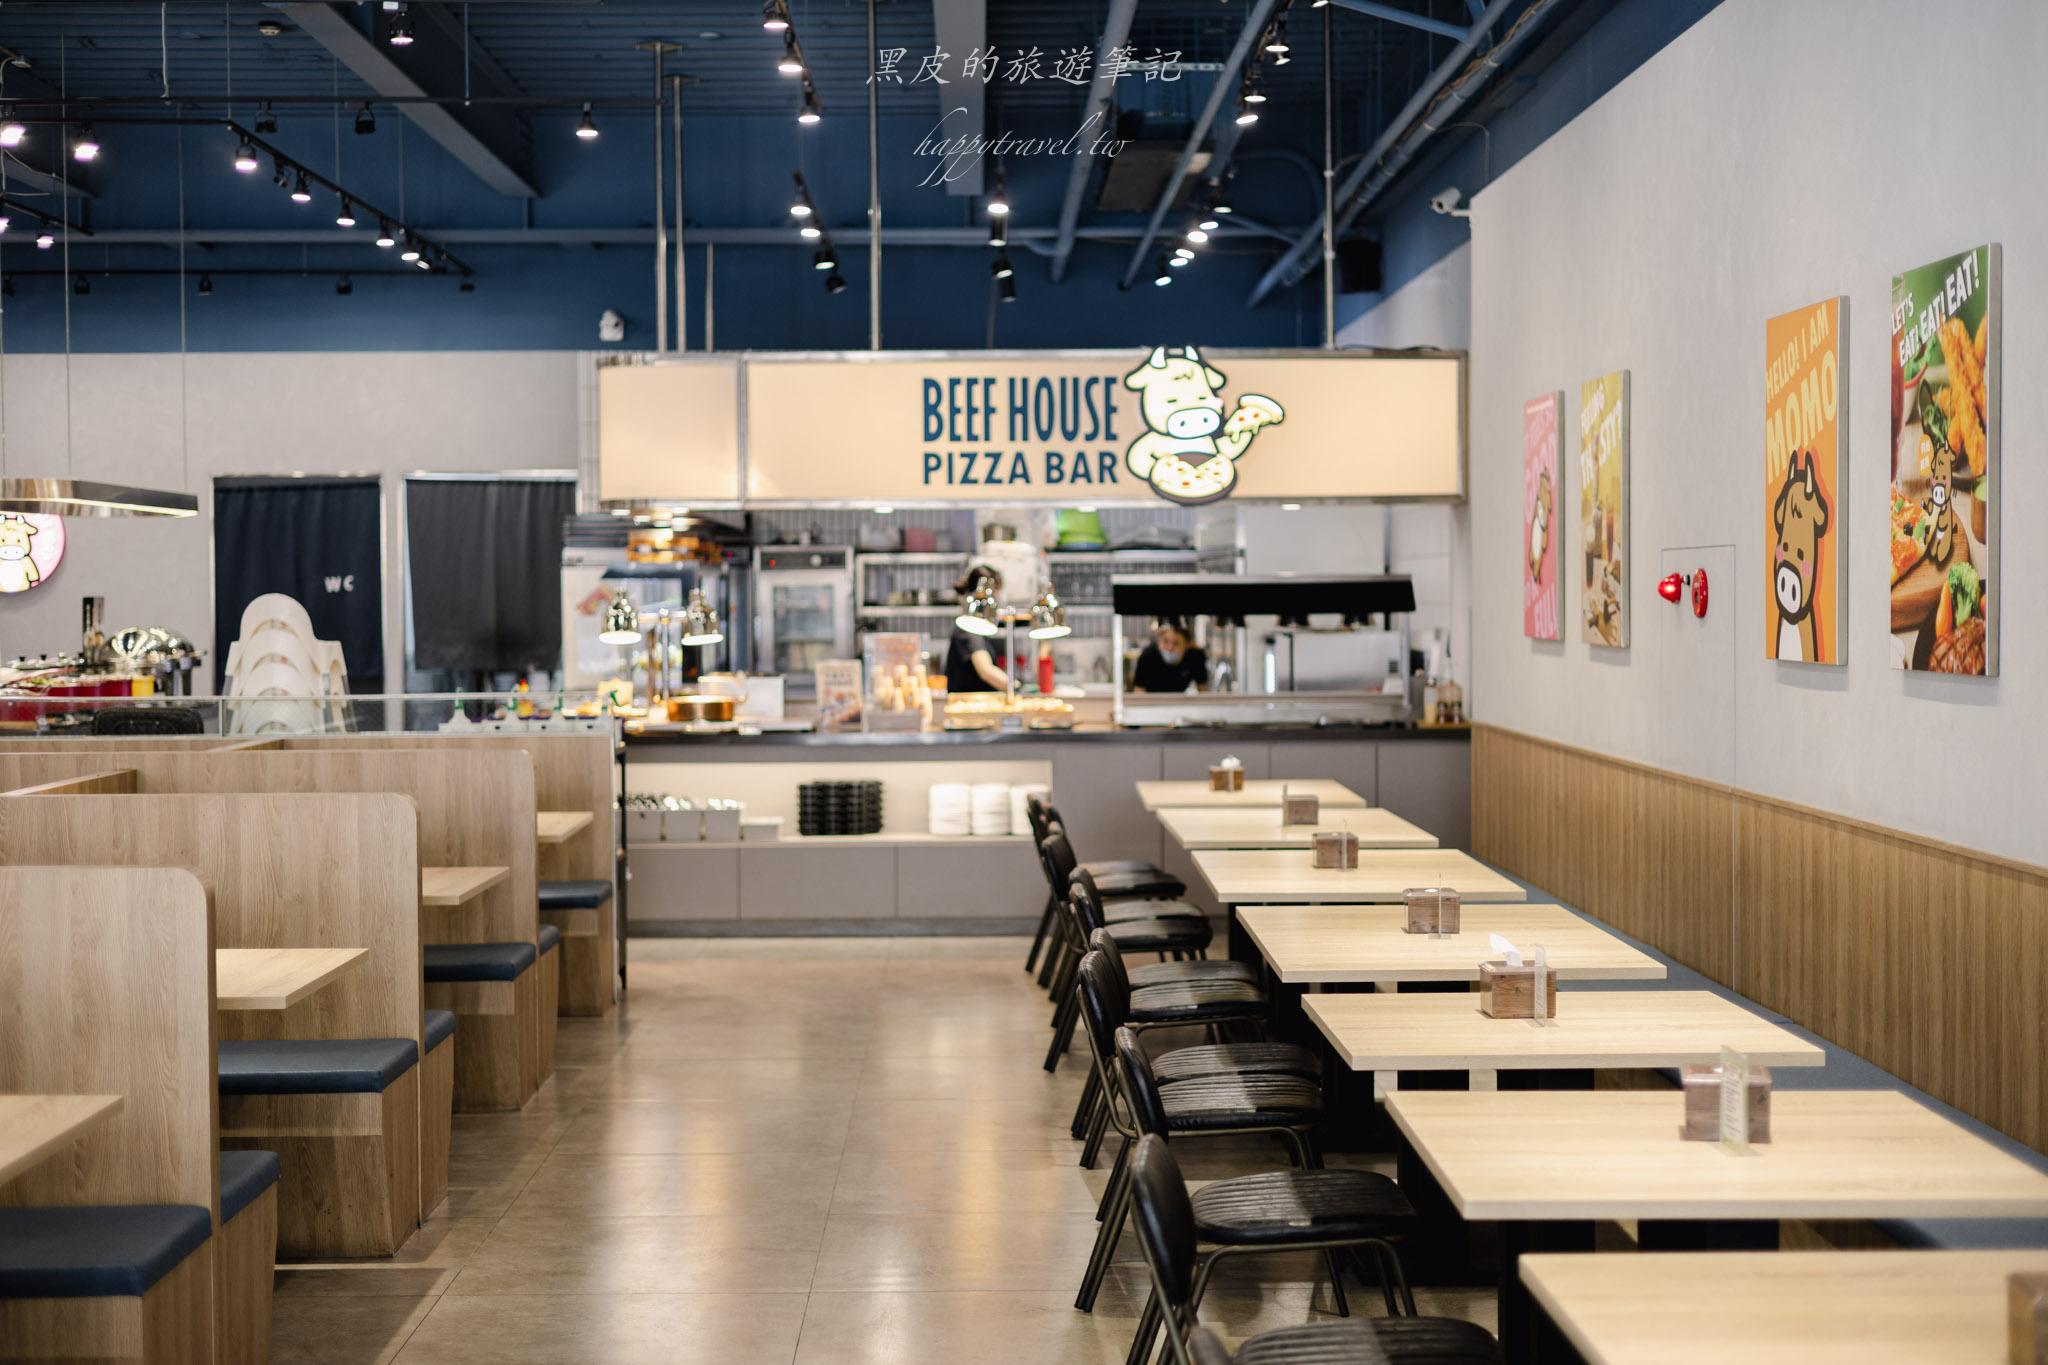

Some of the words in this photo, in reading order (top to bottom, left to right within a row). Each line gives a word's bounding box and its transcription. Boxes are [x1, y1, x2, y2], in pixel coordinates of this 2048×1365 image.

[1892, 292, 1914, 336] LET'S
[1900, 329, 1921, 368] EAT!
[1920, 292, 1947, 344] EAT!
[1946, 250, 1980, 316] EAT!
[1766, 337, 1800, 403] HELLO!
[1801, 329, 1807, 359] I
[1809, 302, 1830, 348] AM
[923, 378, 997, 442] BEEF
[1009, 377, 1118, 442] HOUSE
[1766, 350, 1837, 485] MOMO
[923, 452, 1031, 485] PIZZA
[1046, 452, 1118, 485] BAR
[323, 575, 355, 593] WC
